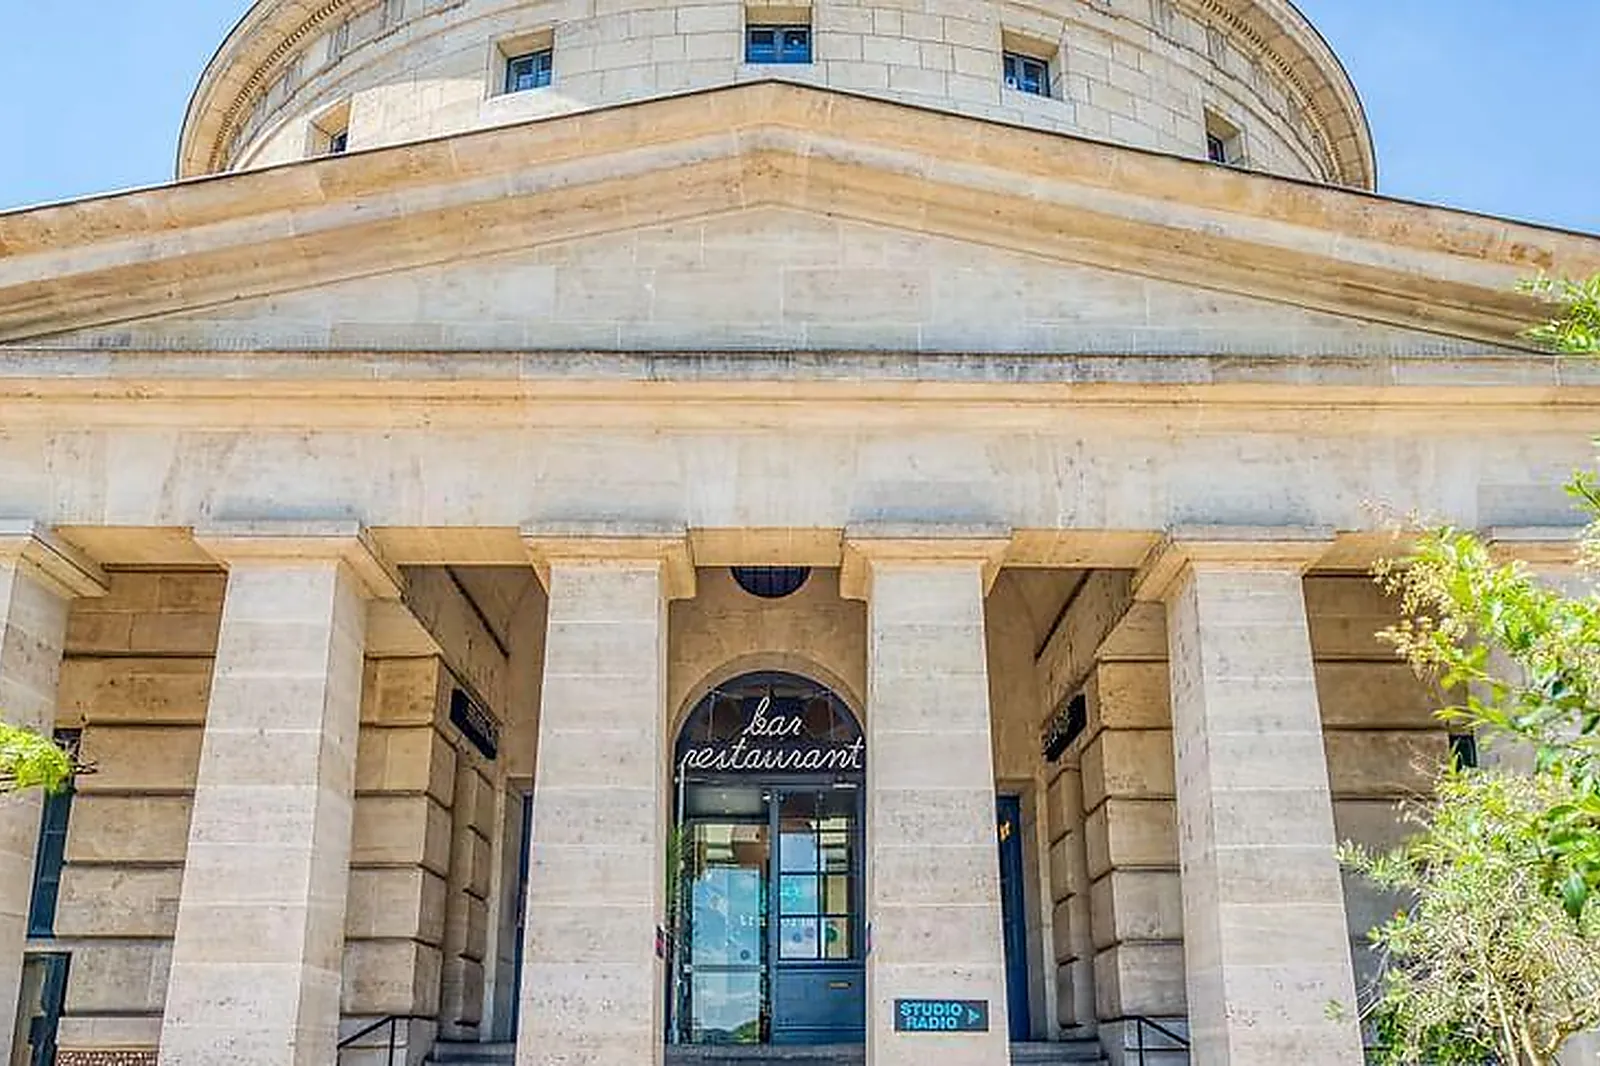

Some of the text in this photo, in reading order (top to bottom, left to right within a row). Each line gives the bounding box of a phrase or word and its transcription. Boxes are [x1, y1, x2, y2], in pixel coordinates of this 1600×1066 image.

[742, 696, 804, 736] bar
[680, 736, 865, 769] restaurant
[900, 1002, 963, 1016] STUDIO
[905, 1016, 957, 1030] RADIO
